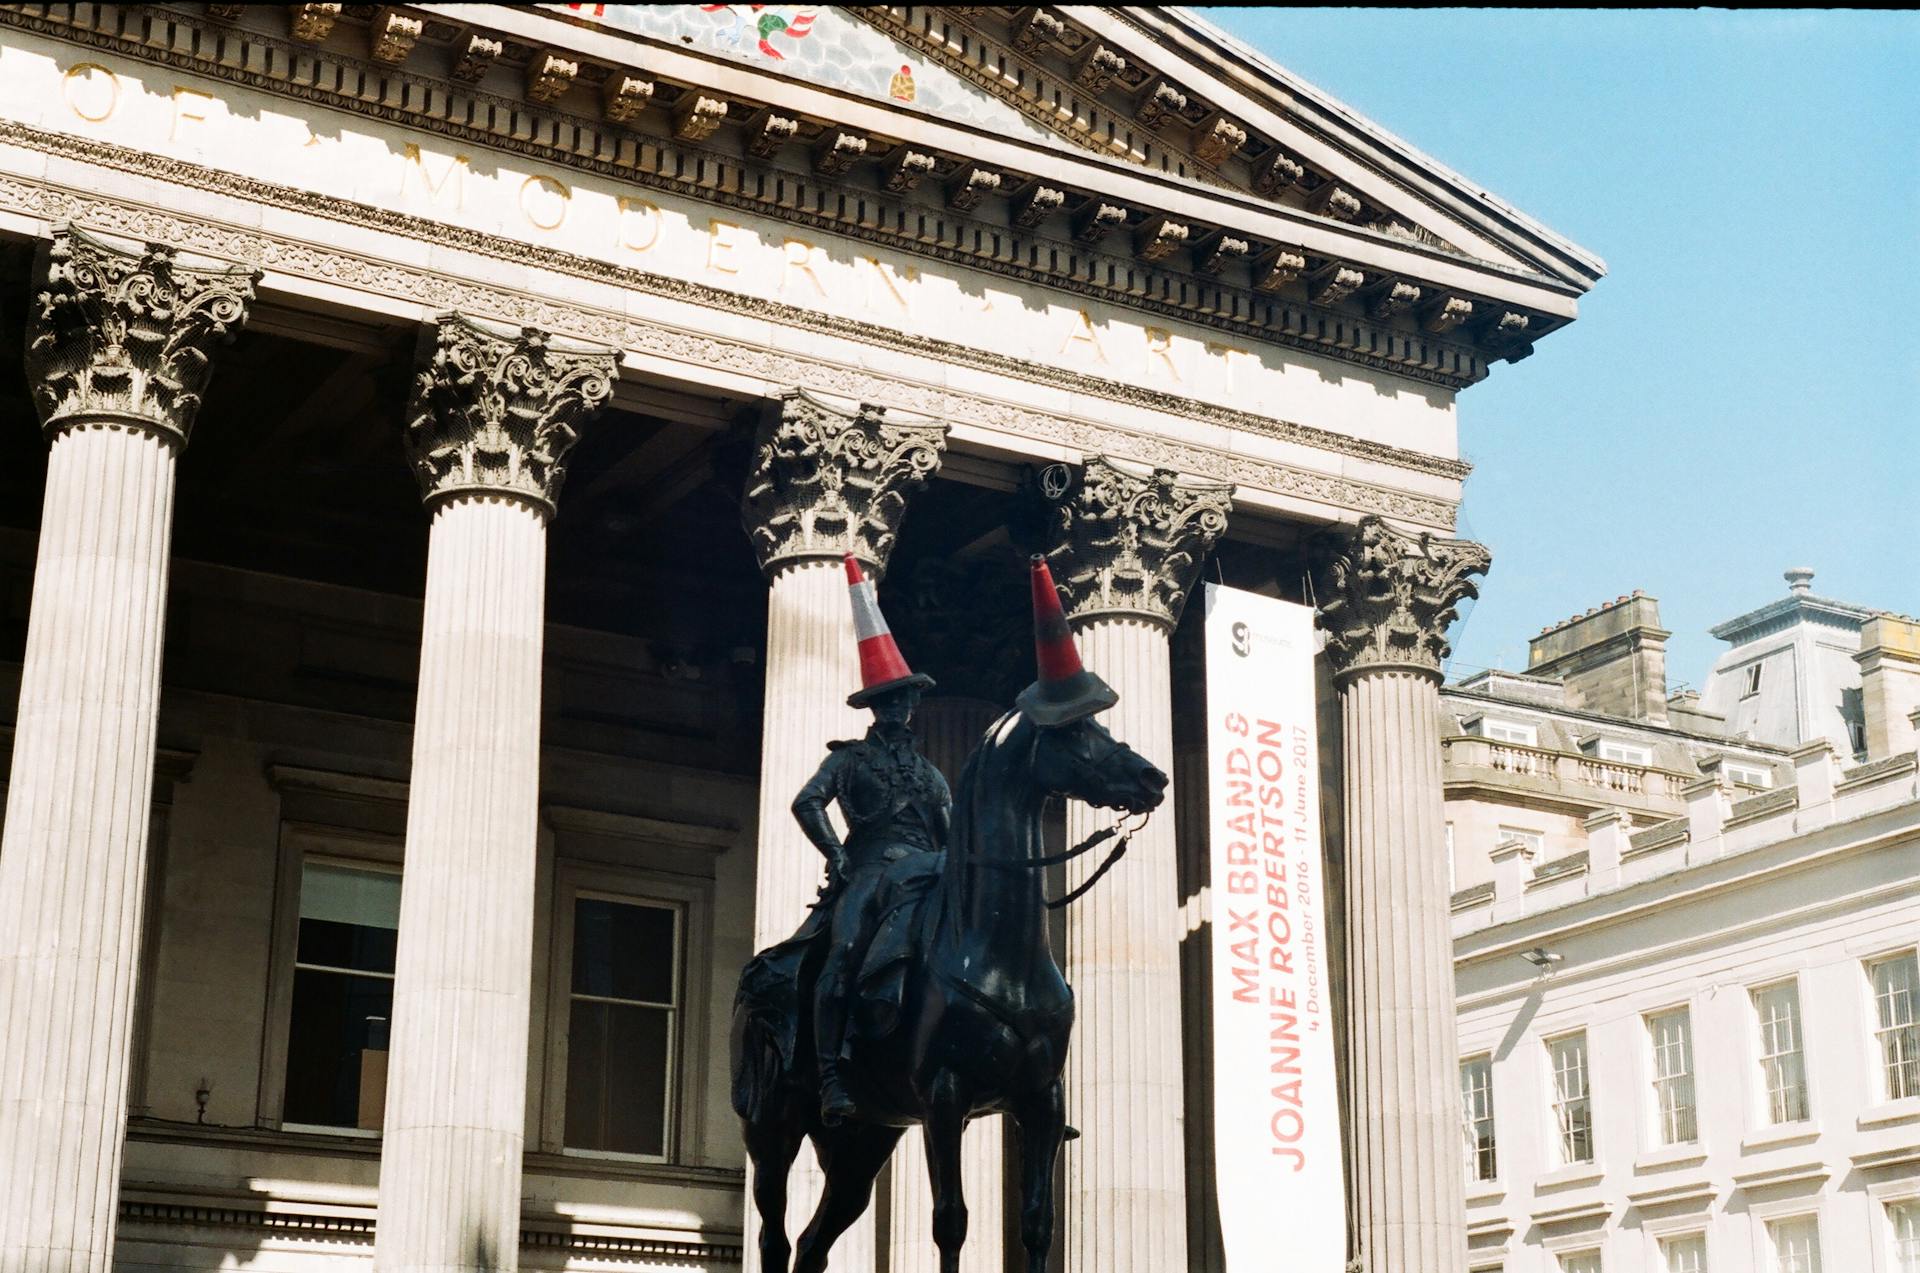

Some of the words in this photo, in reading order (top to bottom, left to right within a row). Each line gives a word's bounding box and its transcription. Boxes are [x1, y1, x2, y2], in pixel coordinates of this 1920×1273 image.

[61, 63, 213, 143] OF
[399, 142, 916, 316] MODERN
[1059, 309, 1249, 395] ART
[1225, 712, 1249, 738] &
[1293, 726, 1308, 769] 2017
[1225, 747, 1259, 895] BRAND
[1294, 774, 1308, 824] June
[1294, 826, 1307, 843] 11
[1256, 718, 1294, 974] ROBERTSON
[1296, 862, 1311, 906] 2016
[1227, 908, 1260, 1004] MAX
[1301, 910, 1320, 1014] December
[1308, 1020, 1320, 1032] 4
[1270, 986, 1306, 1172] JOANNE
